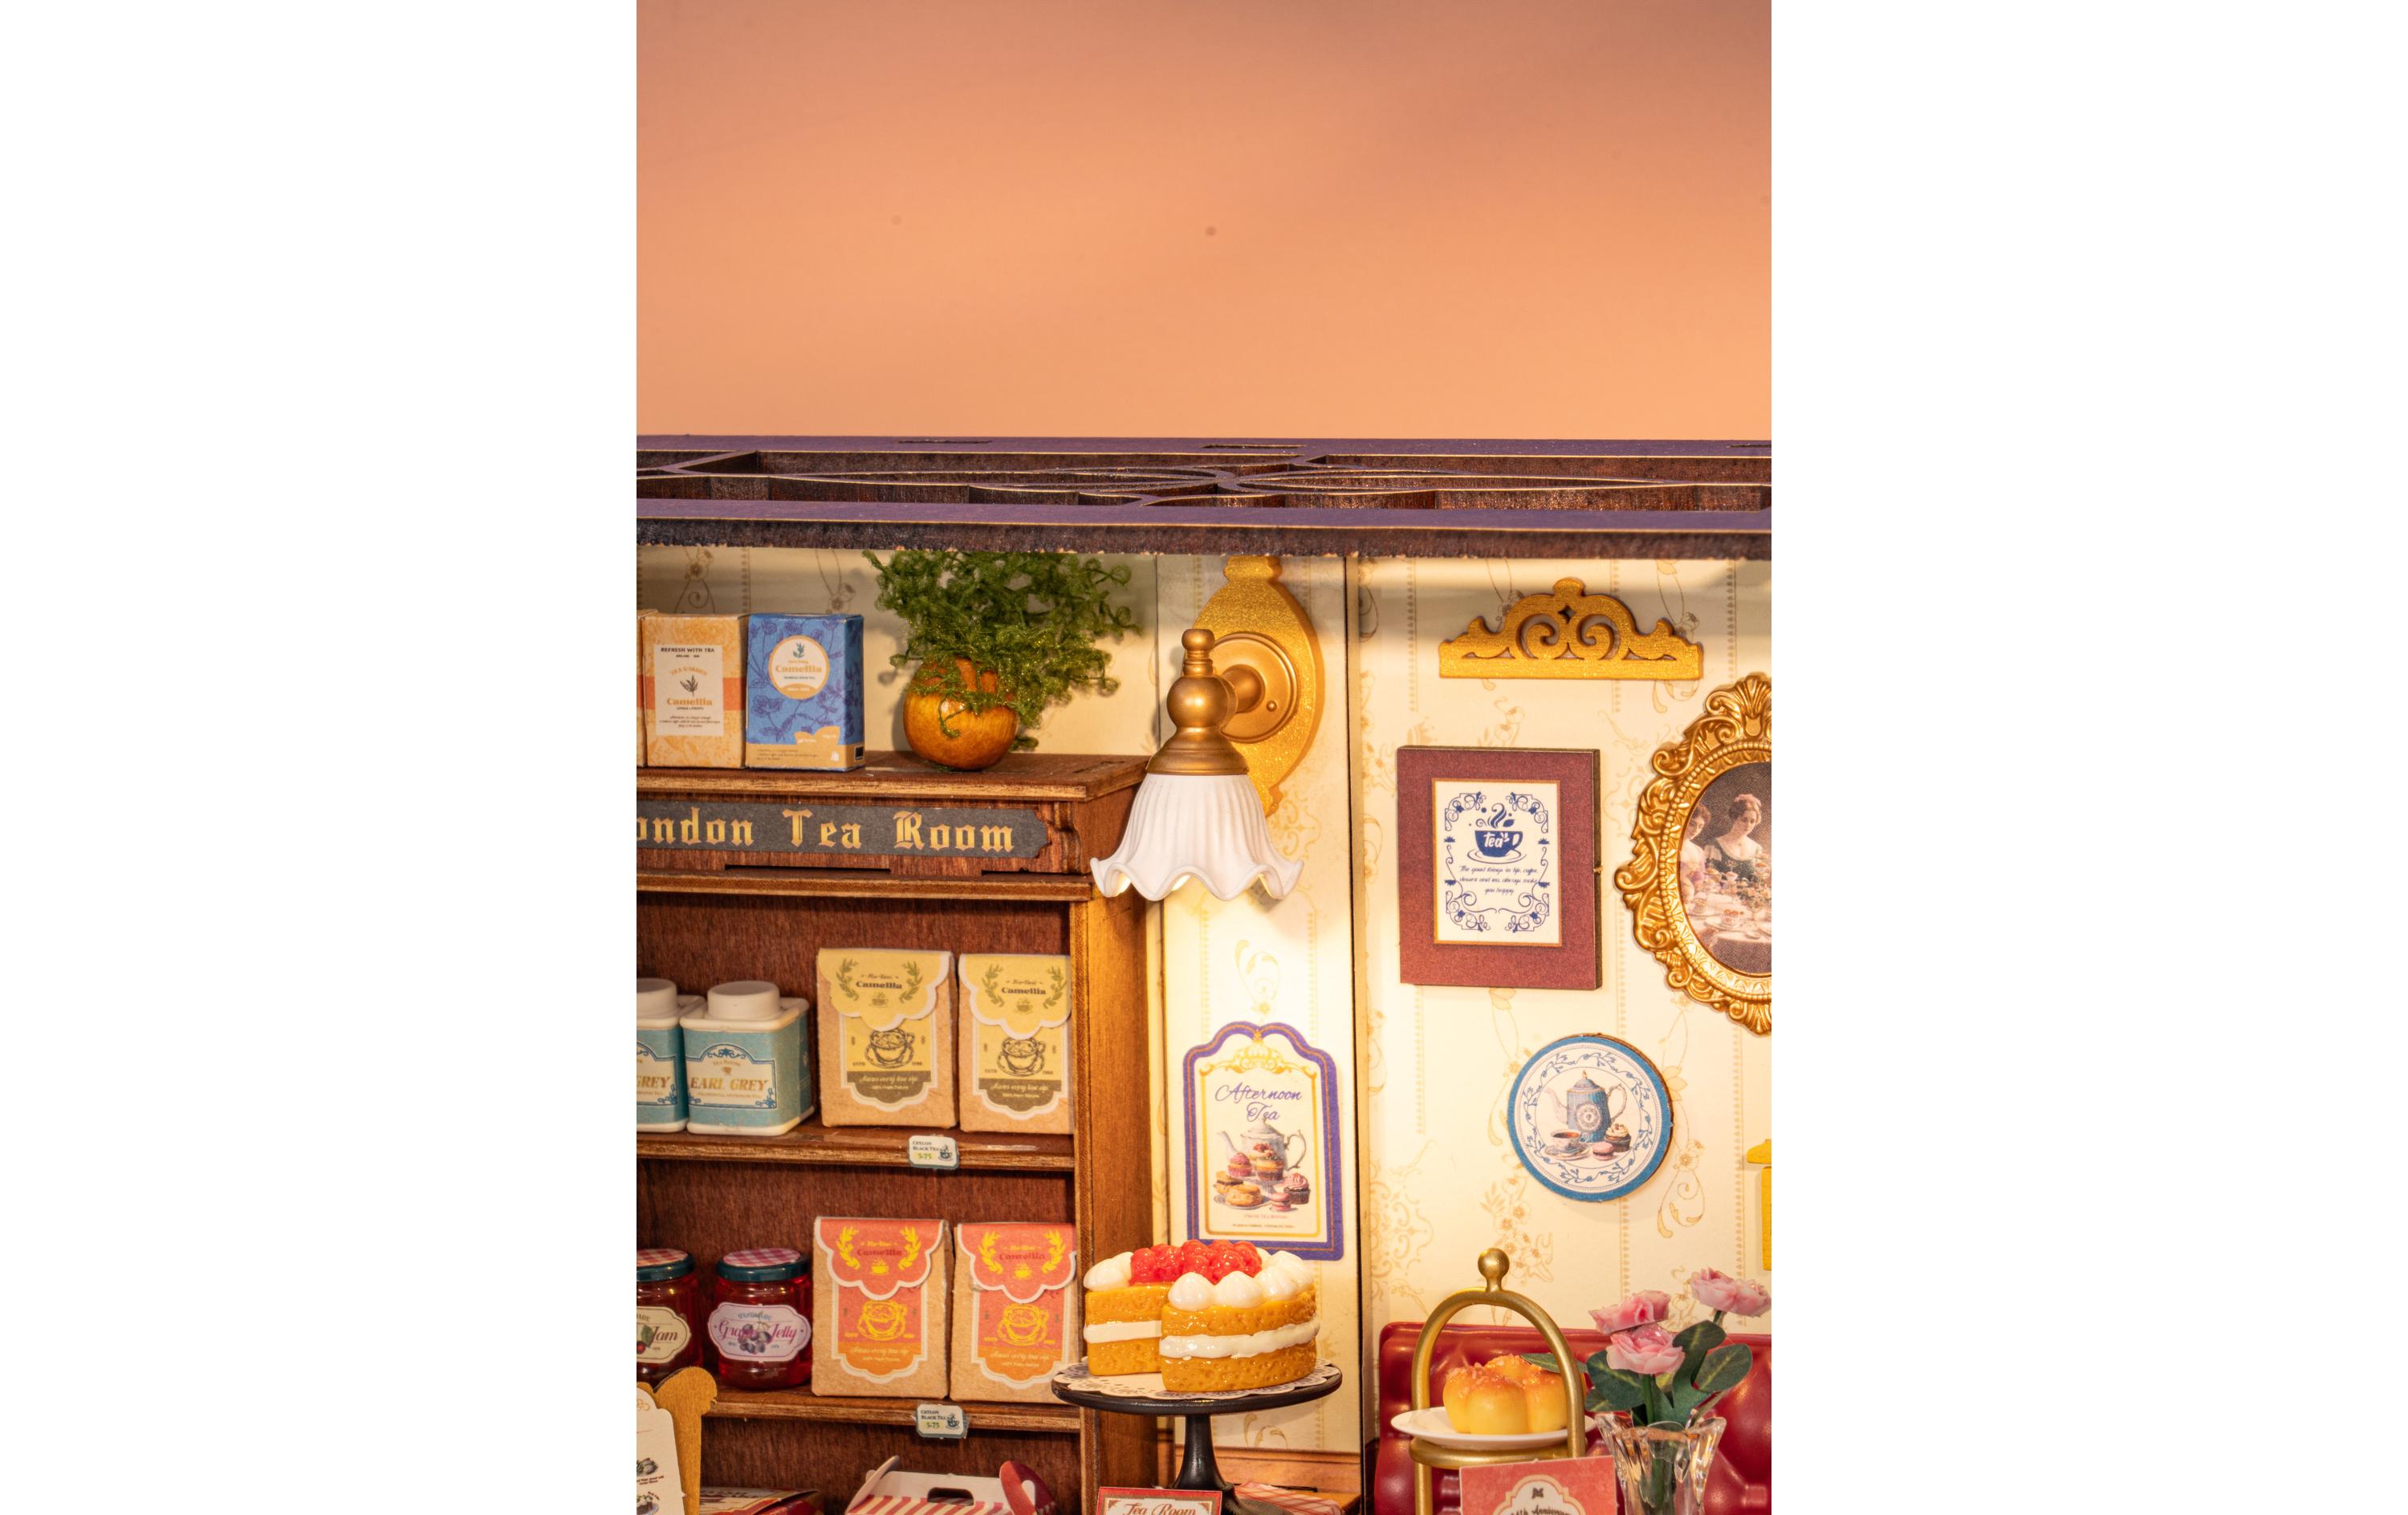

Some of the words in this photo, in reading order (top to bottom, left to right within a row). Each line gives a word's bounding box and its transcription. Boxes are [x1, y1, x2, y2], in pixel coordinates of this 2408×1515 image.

[775, 664, 823, 673] Camellia
[666, 697, 713, 706] Camellia
[782, 808, 863, 849] Tea
[893, 810, 1015, 853] Room
[1470, 866, 1486, 875] good
[855, 981, 903, 989] Camellia
[1001, 986, 1047, 996] Camellia
[689, 1076, 724, 1090] EARL
[729, 1078, 768, 1092] GREY
[1214, 1082, 1303, 1104] Afternoon
[1246, 1102, 1281, 1123] Tea
[856, 1248, 903, 1257] Camellia
[999, 1252, 1046, 1261] Camellia
[649, 1326, 678, 1346] Jam
[769, 1322, 797, 1345] Jelly
[1122, 1502, 1149, 1515] Tea
[1151, 1503, 1196, 1515] Room
